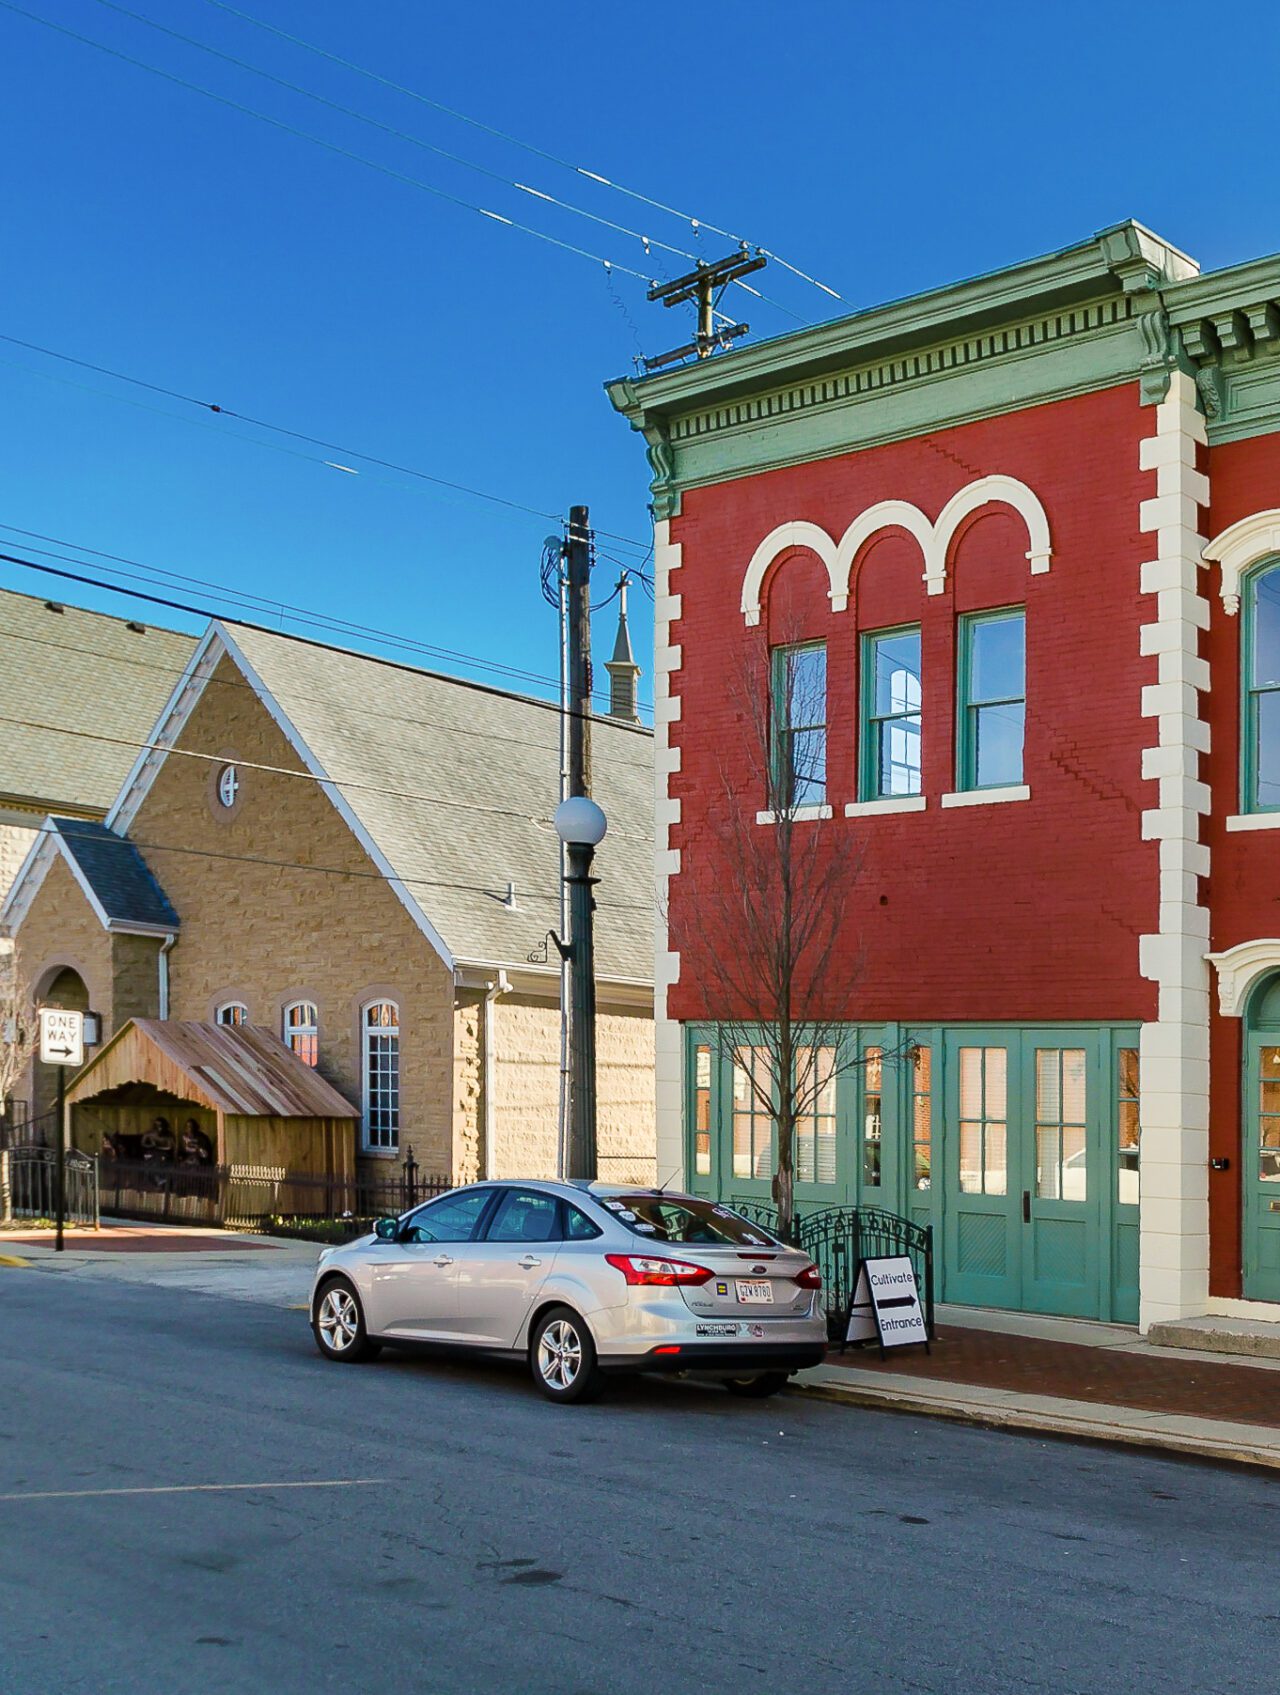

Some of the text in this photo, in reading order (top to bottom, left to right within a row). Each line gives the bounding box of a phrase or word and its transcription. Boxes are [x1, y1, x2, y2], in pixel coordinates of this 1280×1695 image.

[48, 1015, 76, 1029] ONE
[47, 1030, 77, 1042] WAY
[871, 1272, 913, 1286] Cultivate
[880, 1316, 922, 1331] Entrance
